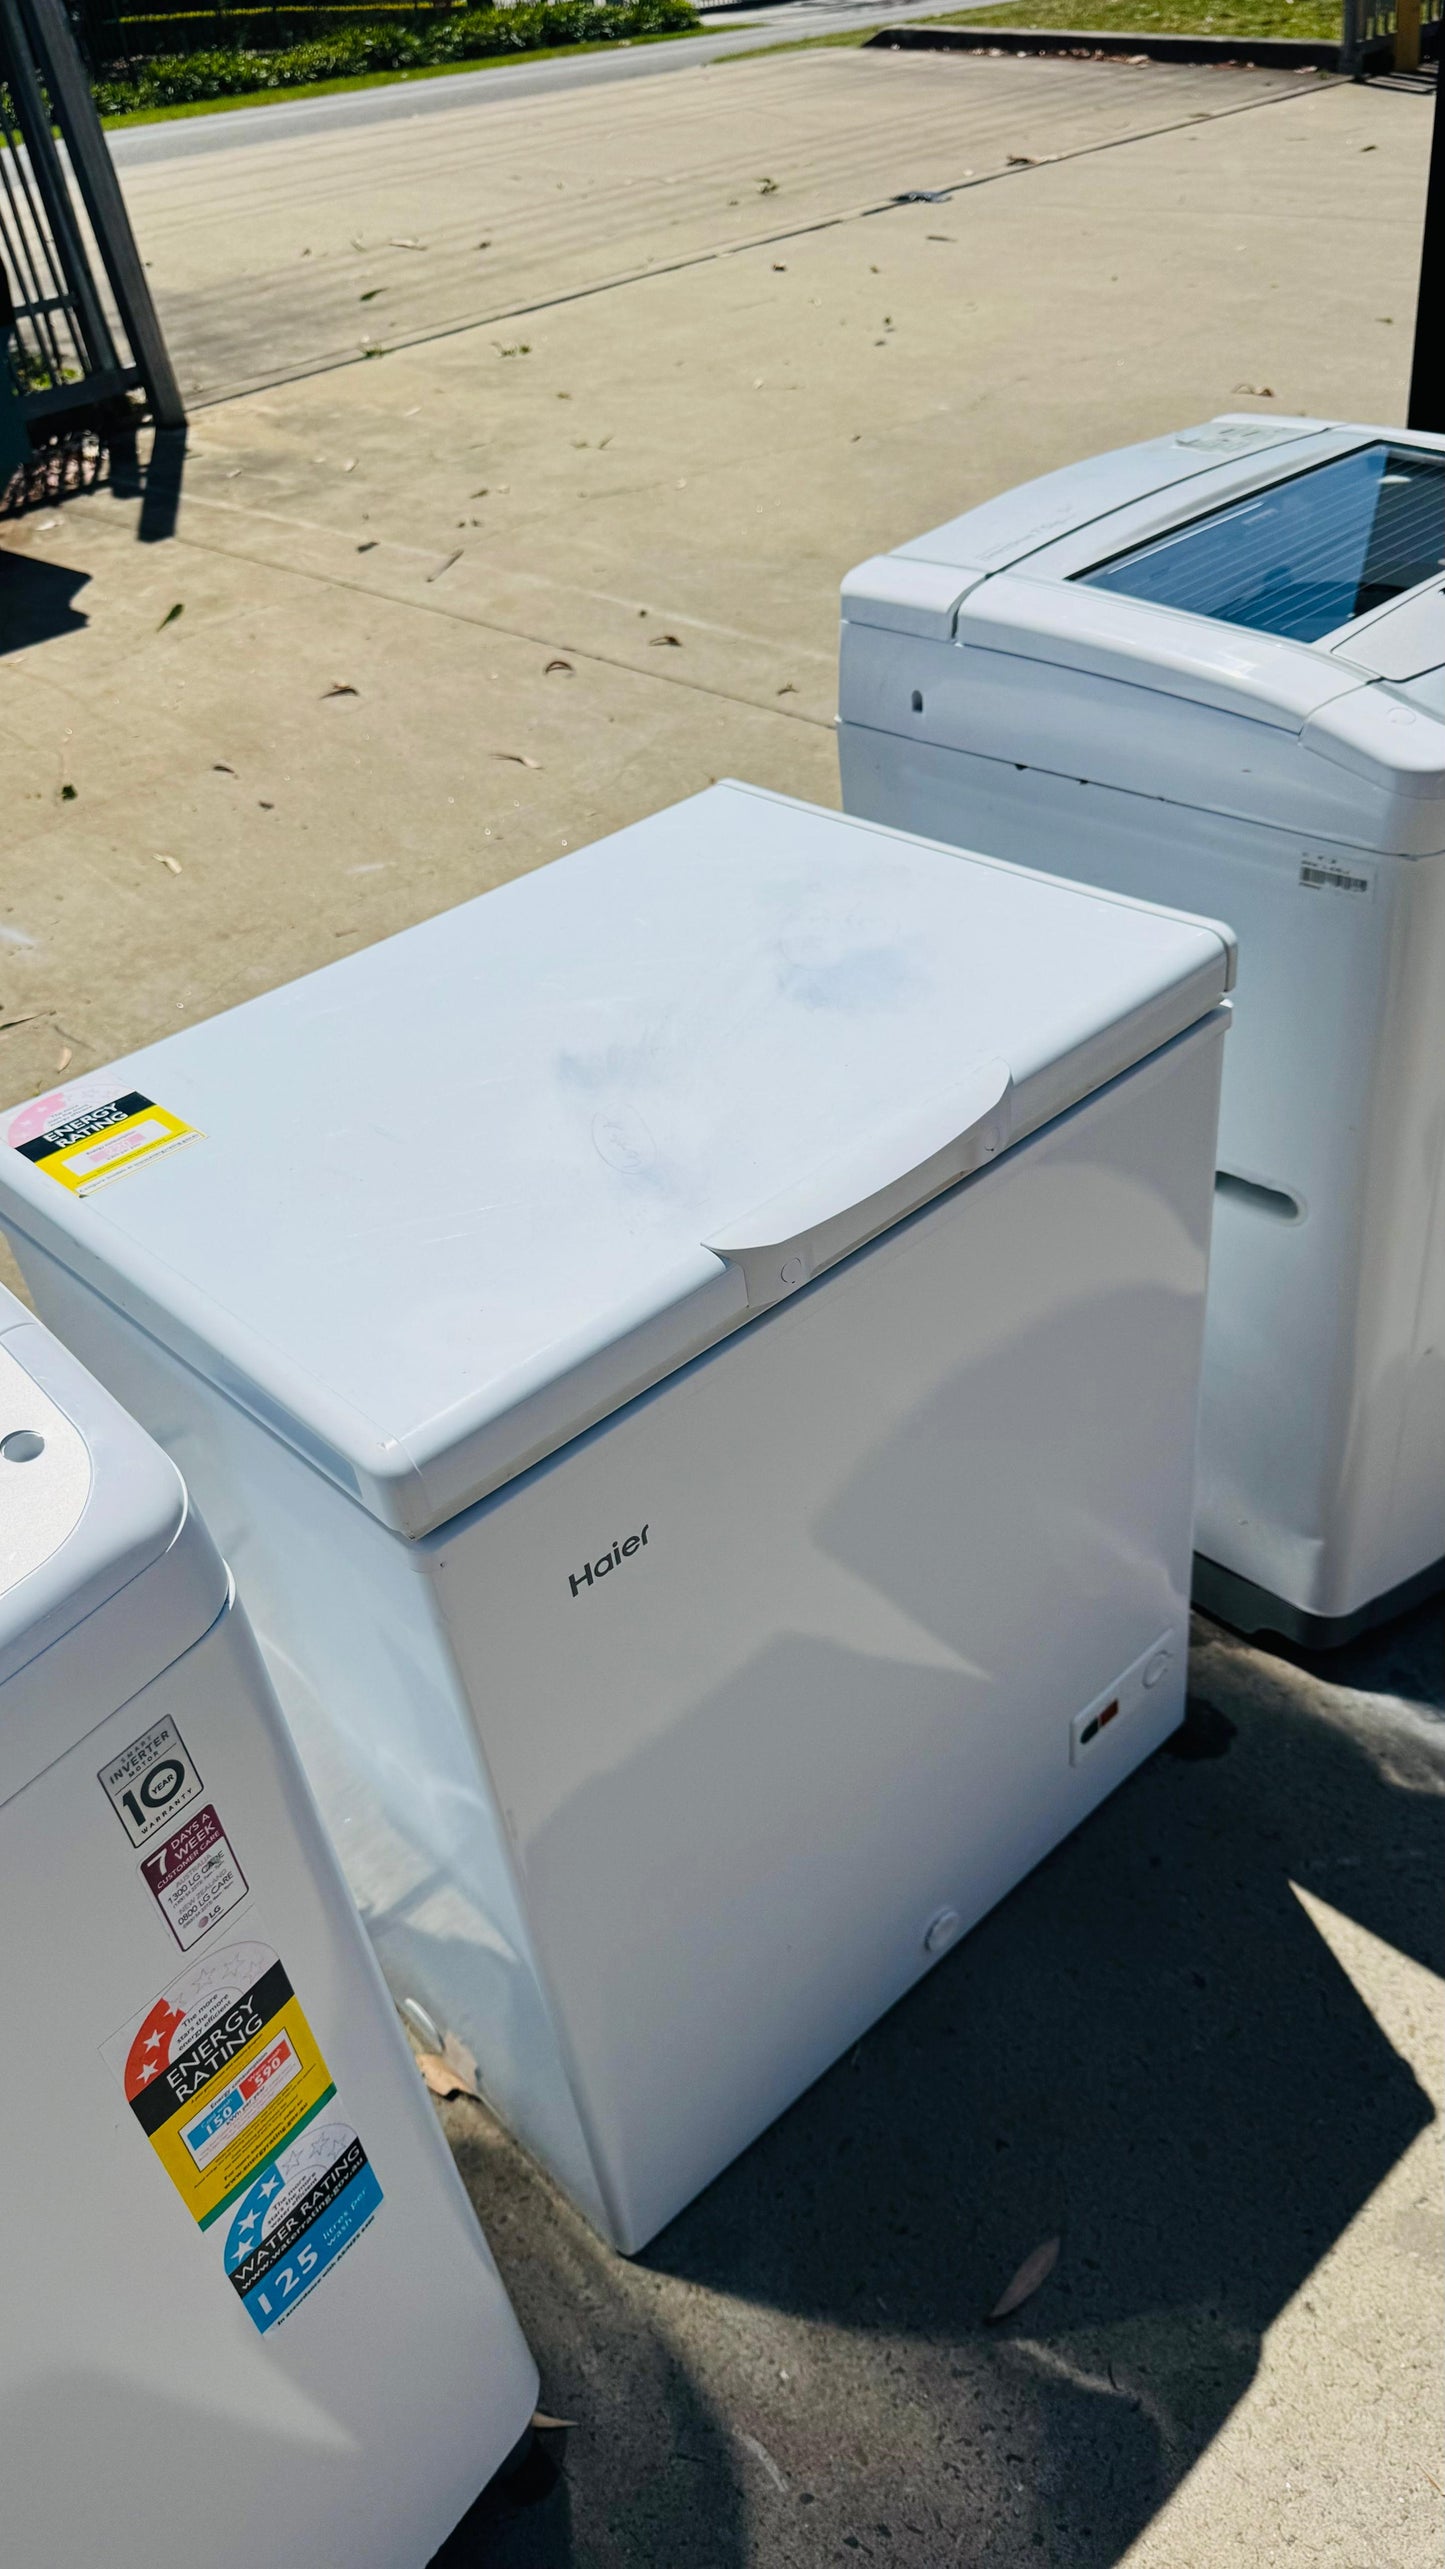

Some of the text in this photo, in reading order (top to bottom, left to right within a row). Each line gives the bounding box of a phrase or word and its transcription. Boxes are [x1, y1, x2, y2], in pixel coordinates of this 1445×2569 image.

[43, 1103, 118, 1142] ENERGY
[56, 1111, 129, 1148] RATING
[568, 1523, 649, 1598] Haier
[109, 1728, 170, 1784] INVERTER
[128, 1749, 159, 1778] MOTOR
[122, 1759, 185, 1827] 10
[151, 1772, 174, 1795] YEAR
[141, 1787, 192, 1835] WARRANTY
[147, 1810, 210, 1881] 7 DAYS A
[157, 1829, 219, 1889] CUSTOMER CARE
[174, 1820, 215, 1862] WEEK
[167, 1883, 188, 1905] 1300
[187, 1872, 200, 1886] LG
[177, 1904, 198, 1926] 0800
[198, 1892, 210, 1907] LG
[210, 1870, 233, 1895] CARE
[208, 1903, 221, 1918] LG
[176, 1993, 229, 2043] stars the more
[177, 1999, 232, 2052] energy efficient
[181, 1992, 219, 2027] The more
[165, 1994, 257, 2089] ENERGY
[175, 2011, 263, 2103] RATING
[253, 2055, 281, 2087] 590
[205, 2104, 233, 2135] 150
[209, 2087, 231, 2110] Energy
[235, 2213, 298, 2284] WATER
[298, 2144, 361, 2215] RATING
[241, 2156, 365, 2292] www.waterrating.gov.au
[321, 2208, 349, 2240] litres
[325, 2216, 352, 2246] wash
[256, 2242, 321, 2315] 125
